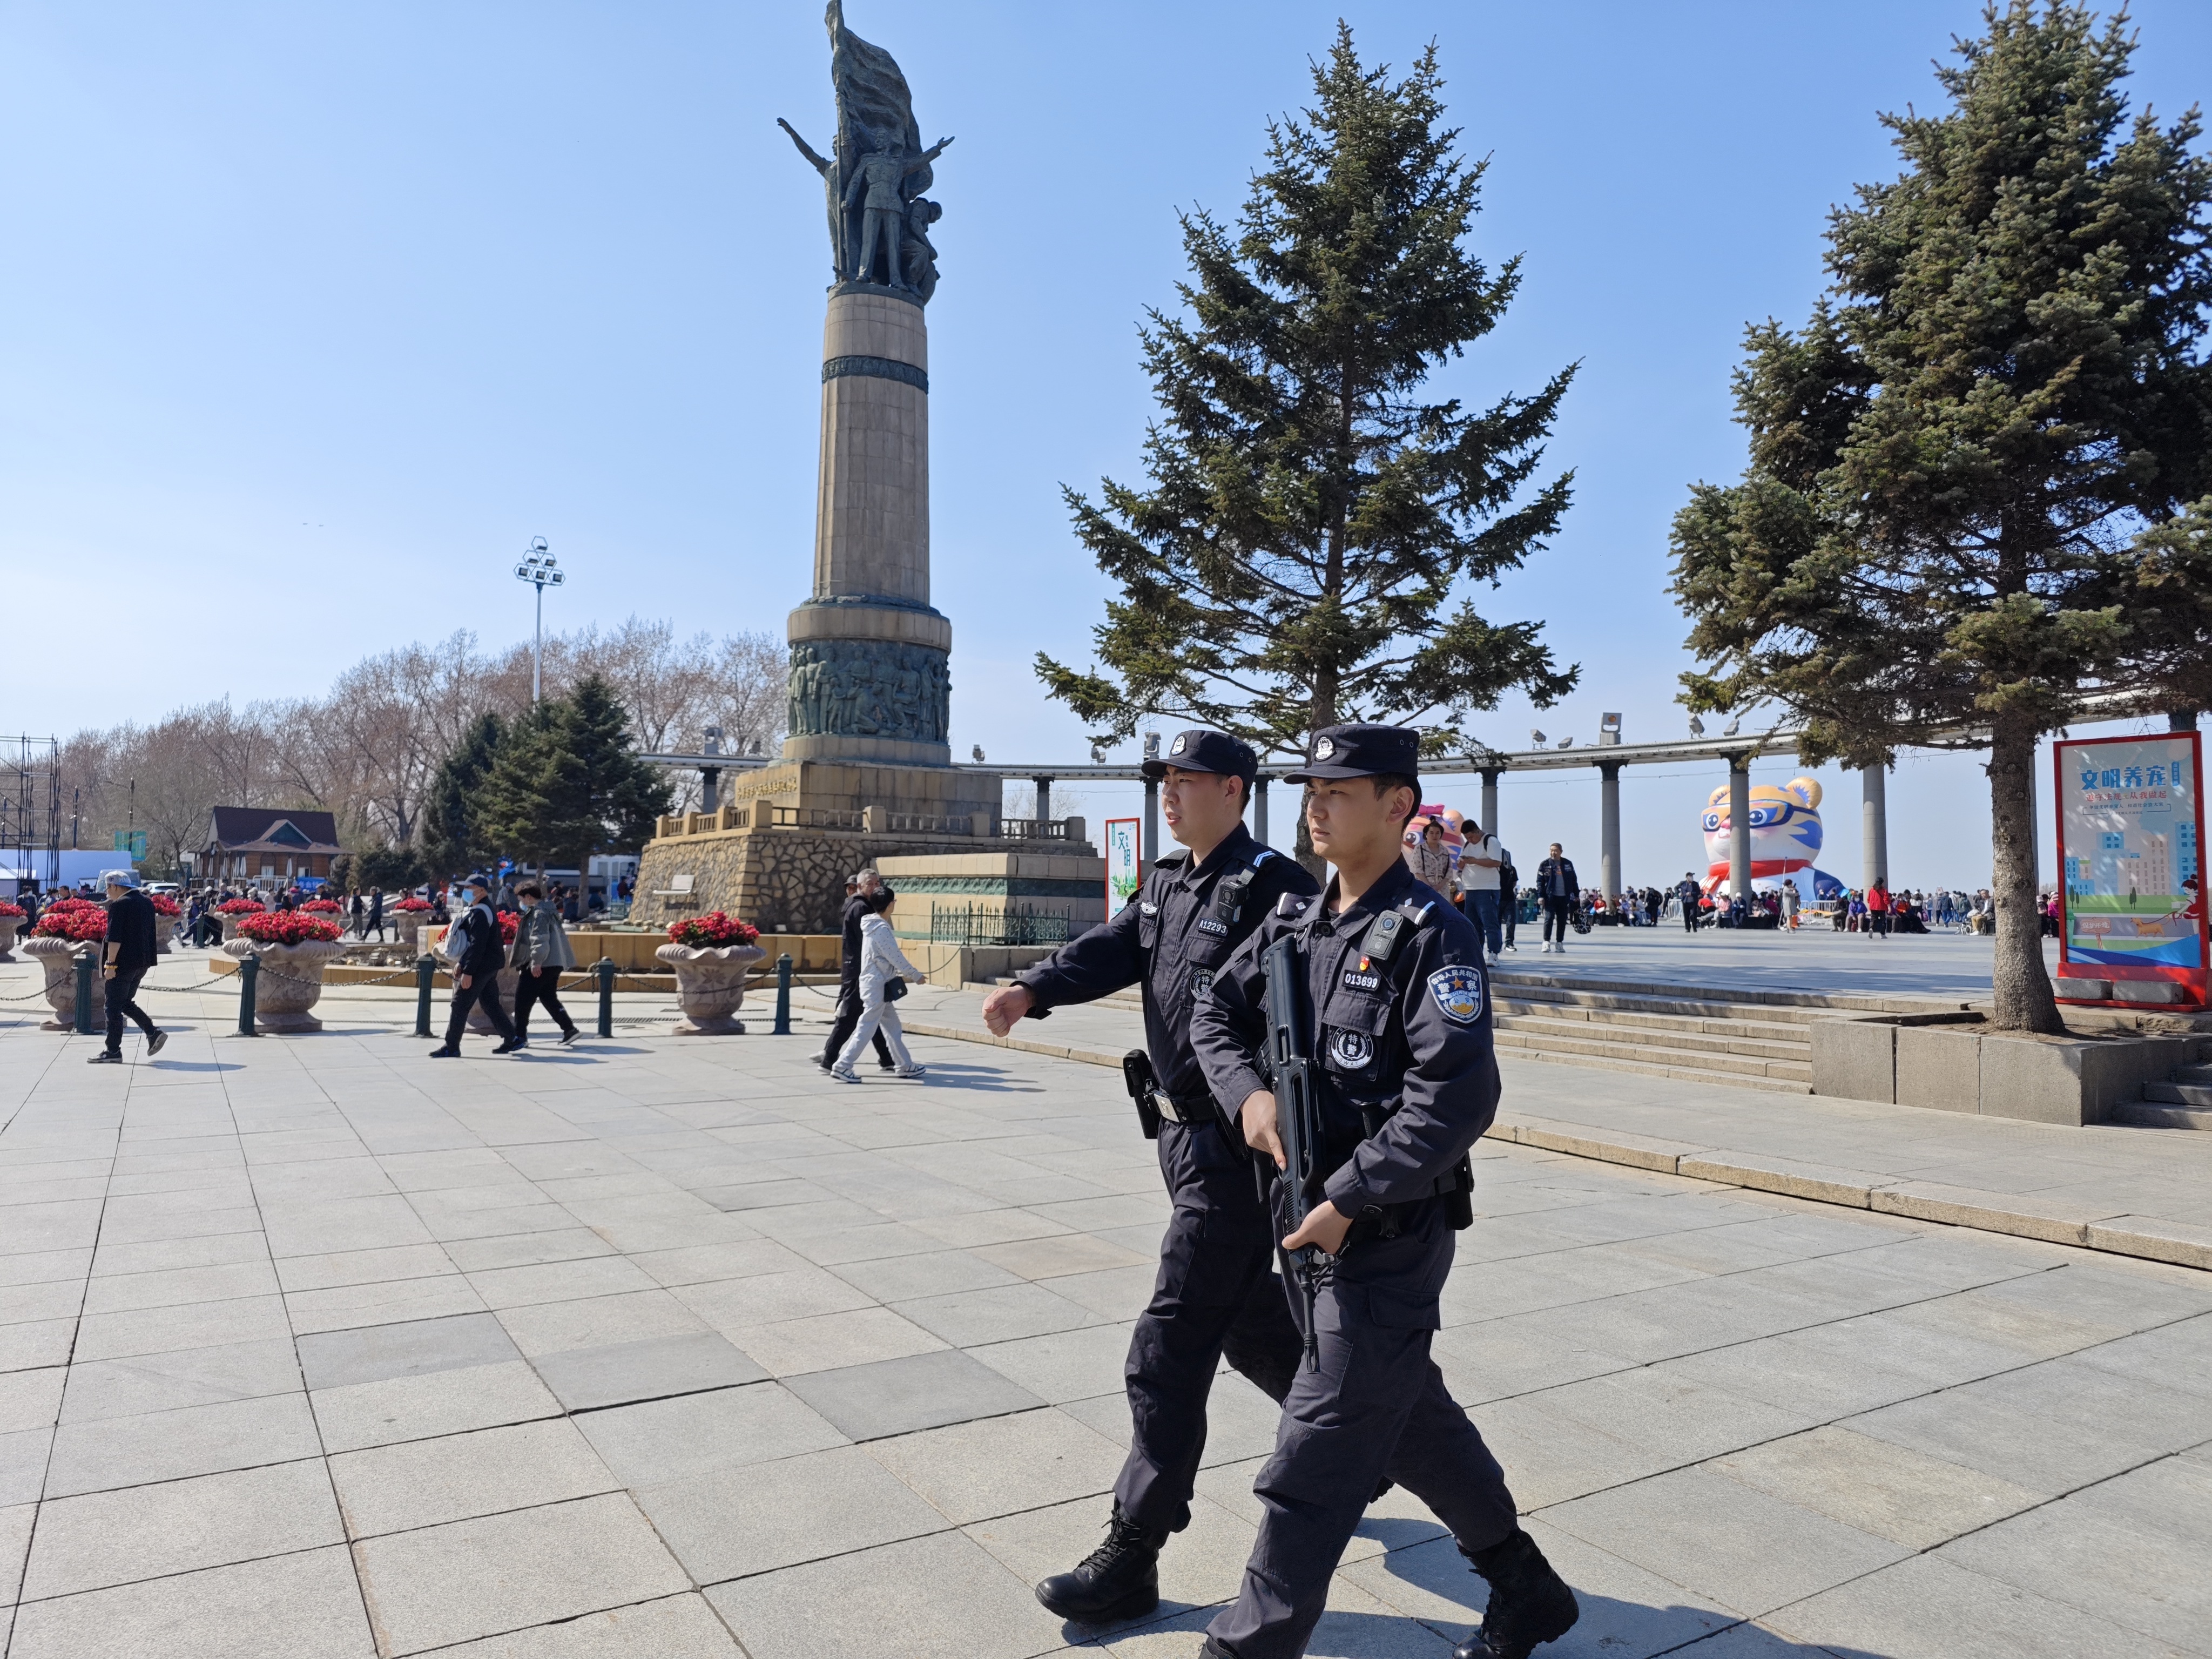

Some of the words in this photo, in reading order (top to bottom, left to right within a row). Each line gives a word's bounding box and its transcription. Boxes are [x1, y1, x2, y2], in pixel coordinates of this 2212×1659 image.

[2080, 765, 2166, 790] 文明养宠
[2130, 790, 2167, 799] 从我做起
[1118, 831, 1130, 867] 文明
[1198, 920, 1227, 934] A12293
[1345, 973, 1378, 988] 013699
[1431, 969, 1478, 986] 中华人民共和国
[1347, 1034, 1358, 1055] 特警
[1339, 1058, 1358, 1066] SWAT
